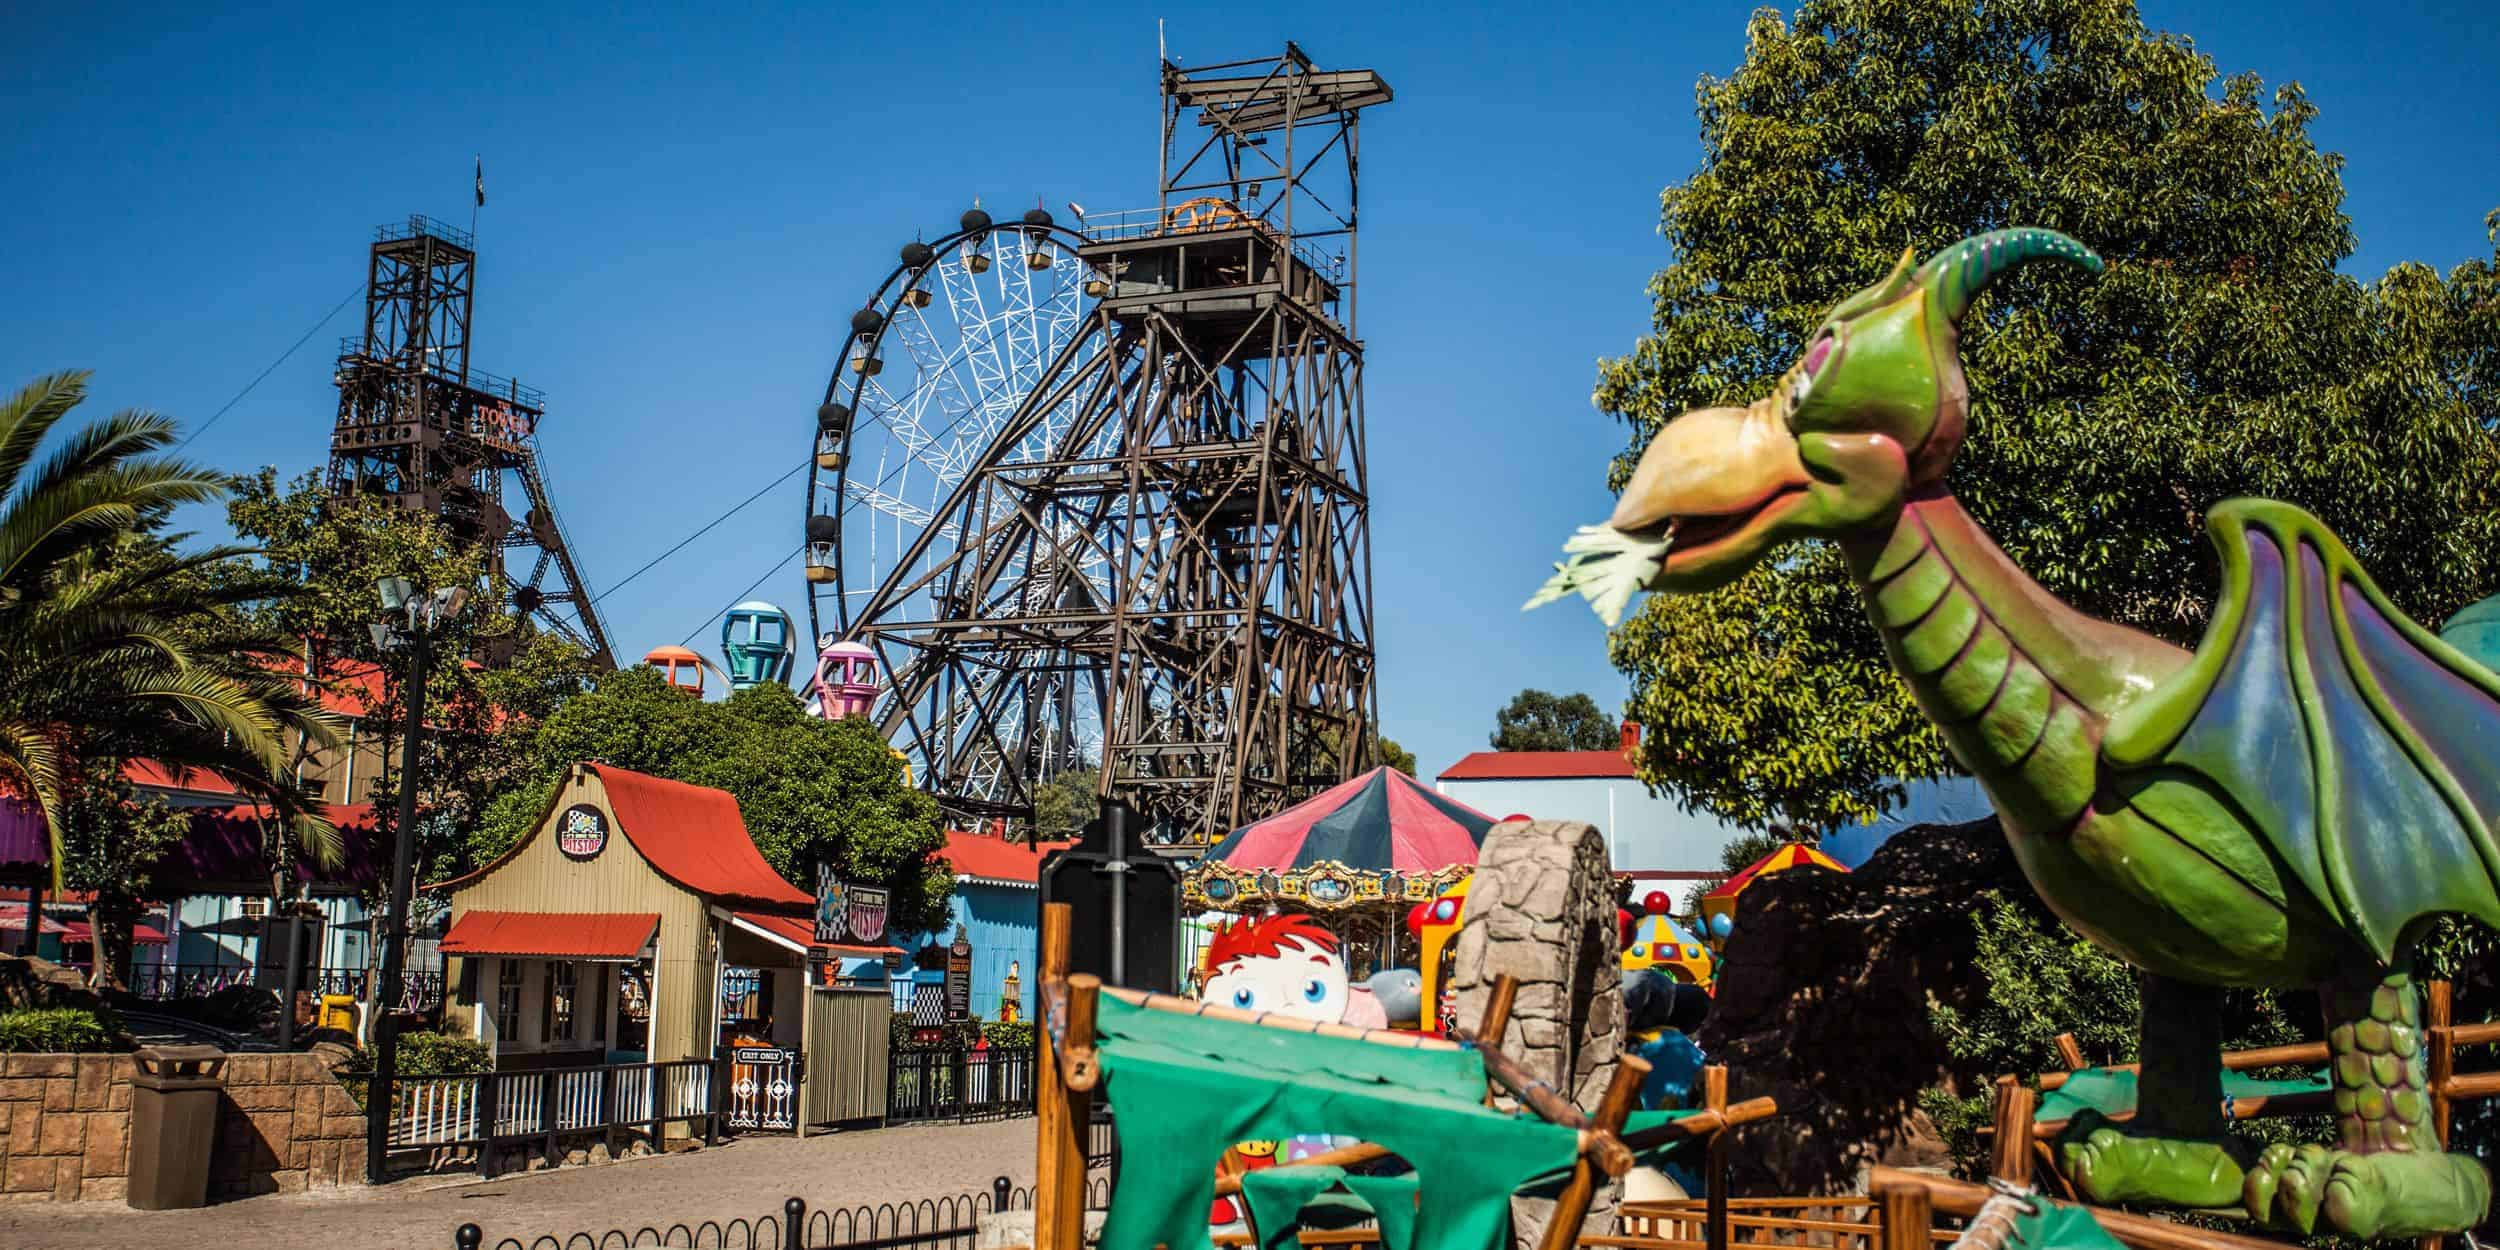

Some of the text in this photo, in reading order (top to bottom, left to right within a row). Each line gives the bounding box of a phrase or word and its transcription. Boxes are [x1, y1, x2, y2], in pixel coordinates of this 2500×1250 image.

[563, 839, 601, 852] PITSTOP
[850, 905, 885, 937] PITSTOP
[742, 1052, 780, 1060] EXIT ONLY
